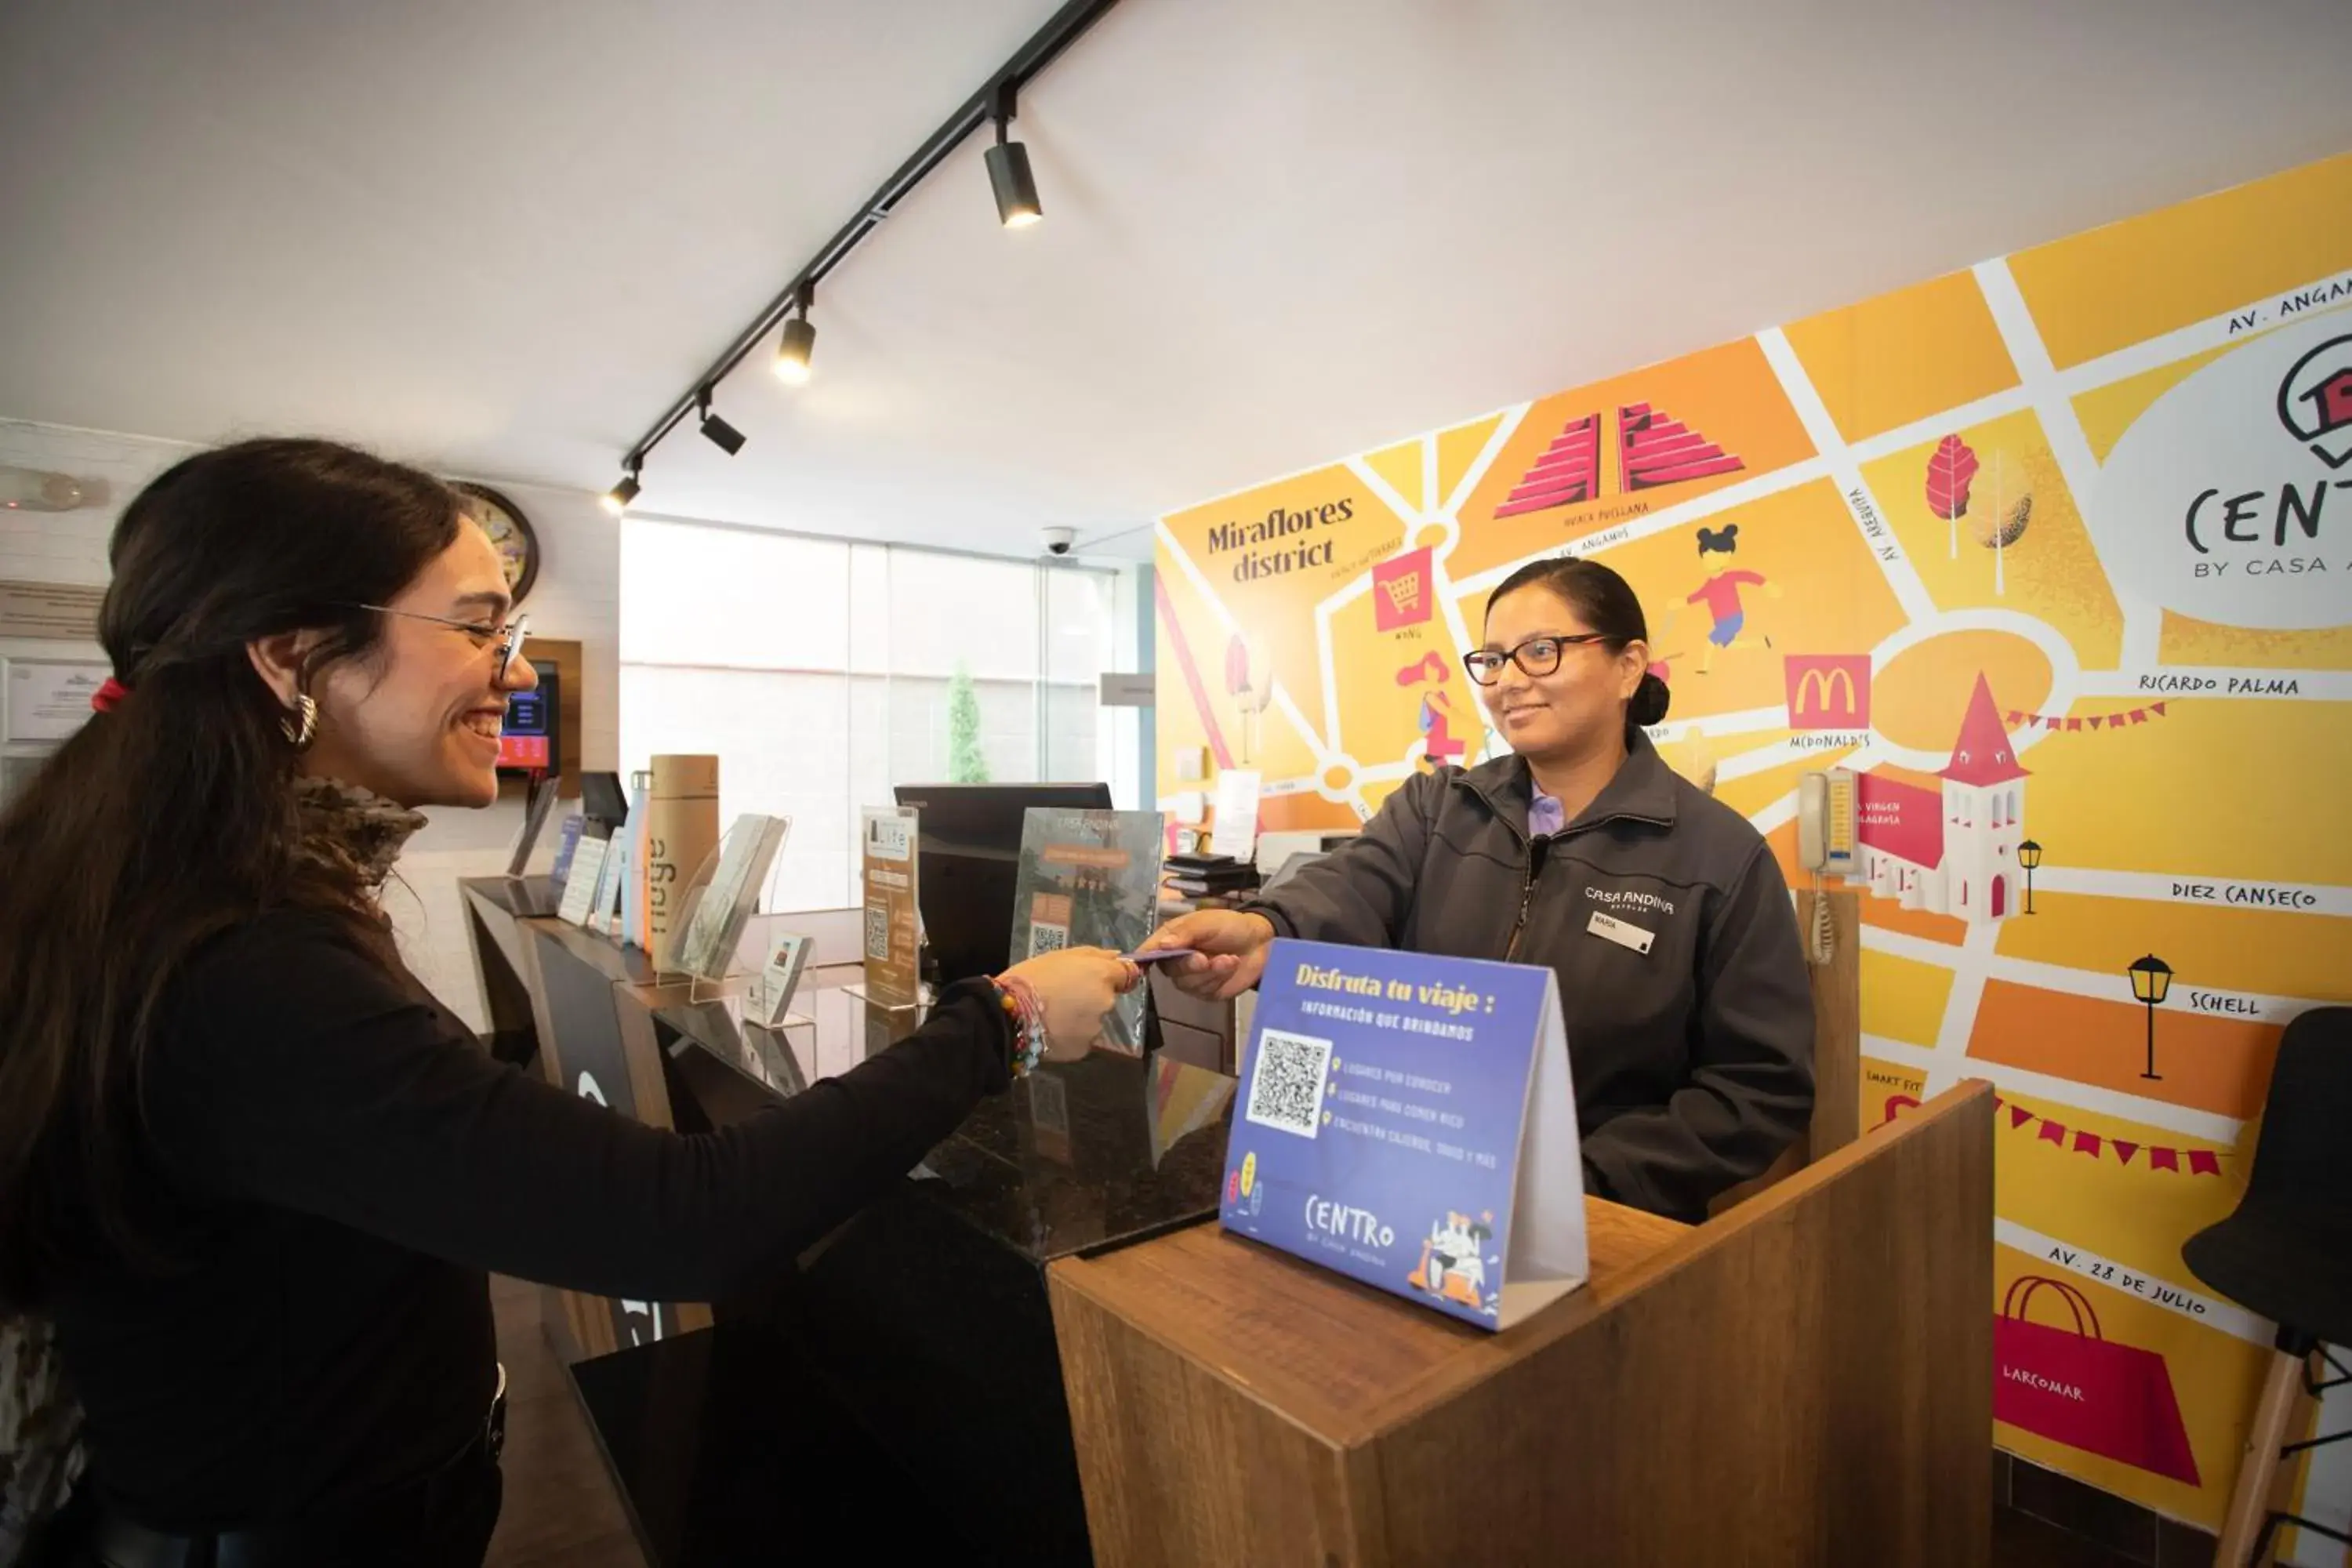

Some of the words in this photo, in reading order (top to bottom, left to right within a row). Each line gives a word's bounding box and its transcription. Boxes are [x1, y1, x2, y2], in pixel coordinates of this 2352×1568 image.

[2229, 310, 2268, 335] AV.
[2280, 277, 2352, 318] ANGA
[1208, 497, 1353, 554] Miraflores
[1232, 535, 1334, 583] district
[2194, 561, 2229, 578] BY
[2245, 557, 2327, 575] CASA
[2139, 674, 2217, 691] RICARDO
[2227, 677, 2299, 695] PALMA
[1584, 887, 1621, 902] CASA
[2172, 883, 2216, 900] DIEZ
[2225, 885, 2317, 909] CANSECO
[1295, 963, 1382, 997] Disfruta
[1386, 978, 1412, 1002] tu
[1418, 980, 1479, 1015] viaje
[2190, 991, 2261, 1014] SCHELL
[1375, 1011, 1401, 1030] QUE
[1305, 1193, 1396, 1249] CENTRO
[2049, 1246, 2082, 1268] AV.
[2091, 1263, 2115, 1280] 28
[2122, 1274, 2146, 1294] DE
[2151, 1286, 2207, 1315] JULIO
[2002, 1364, 2086, 1402] LARCOMAR
